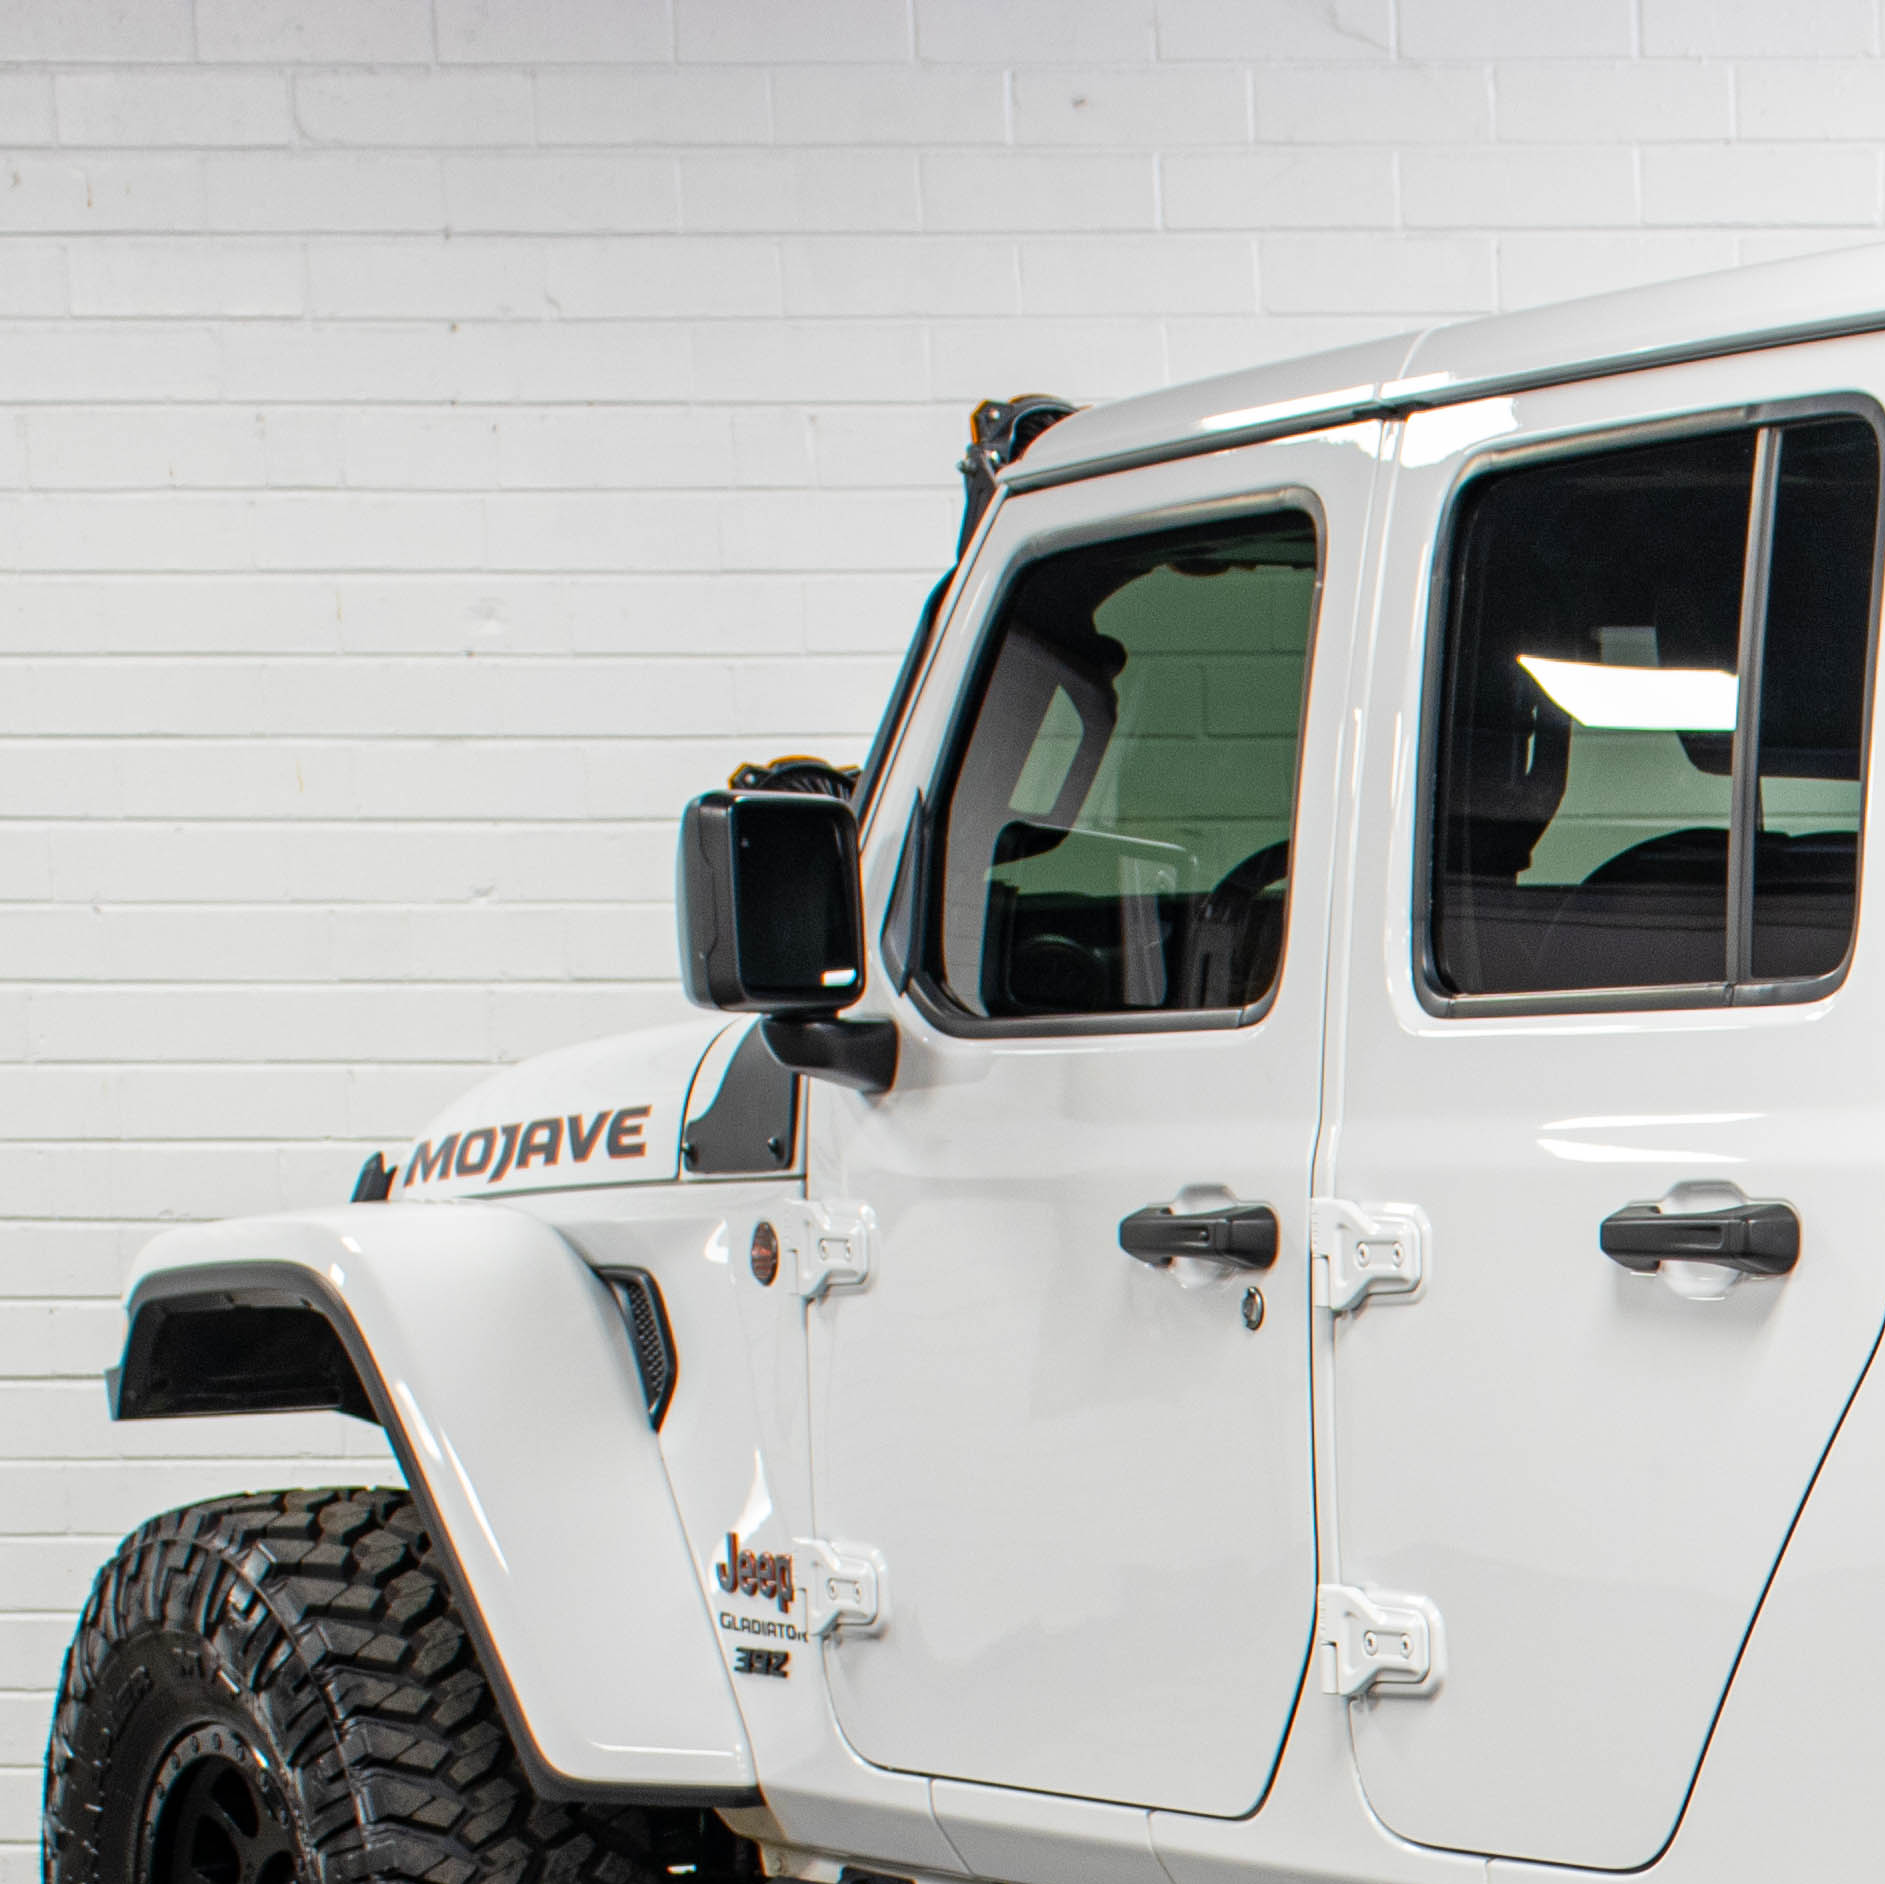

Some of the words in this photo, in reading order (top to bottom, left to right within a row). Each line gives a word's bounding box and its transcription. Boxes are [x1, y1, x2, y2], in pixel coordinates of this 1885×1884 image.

[403, 1104, 652, 1188] MOJAVE
[715, 1531, 795, 1614] Jeep
[719, 1611, 809, 1644] GLADIATOR
[734, 1646, 791, 1679] 392
